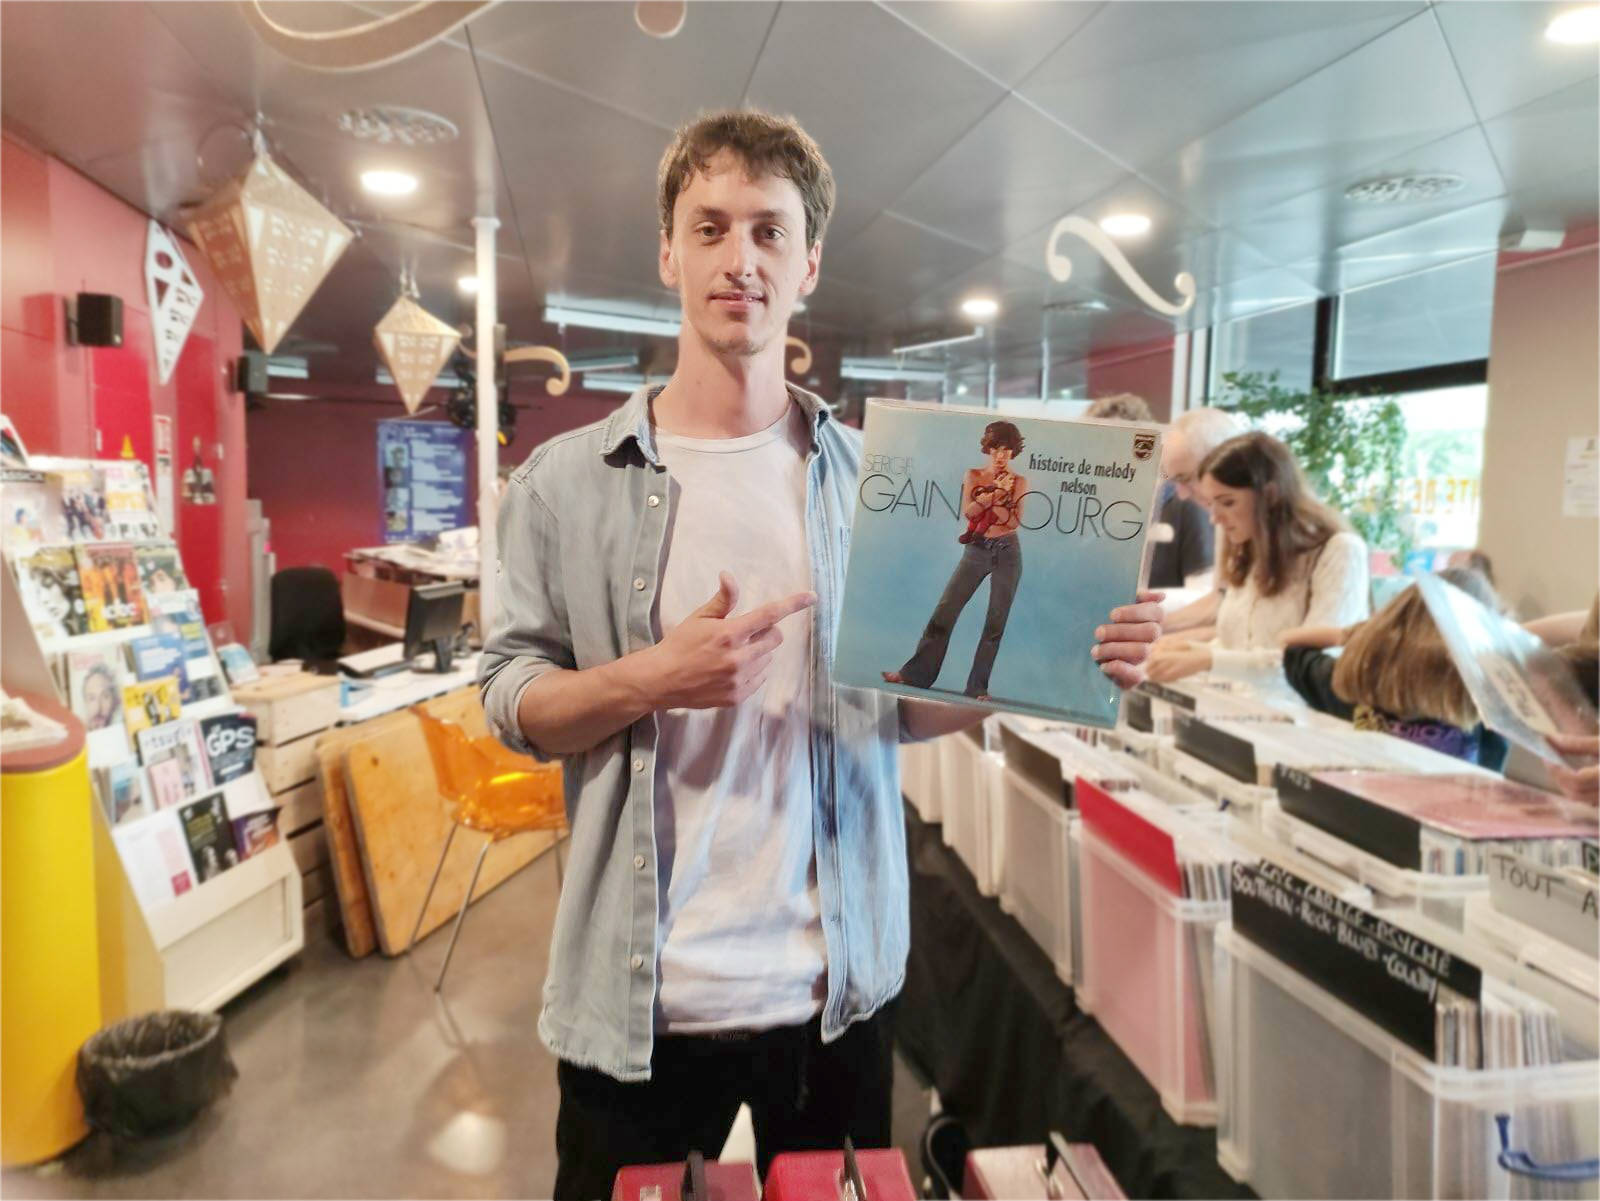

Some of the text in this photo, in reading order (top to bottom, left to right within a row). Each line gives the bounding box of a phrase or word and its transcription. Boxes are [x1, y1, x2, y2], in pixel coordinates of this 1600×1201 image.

[1029, 453, 1136, 482] histoire de melody
[1060, 478, 1097, 495] nelson
[1491, 853, 1567, 899] TOUT
